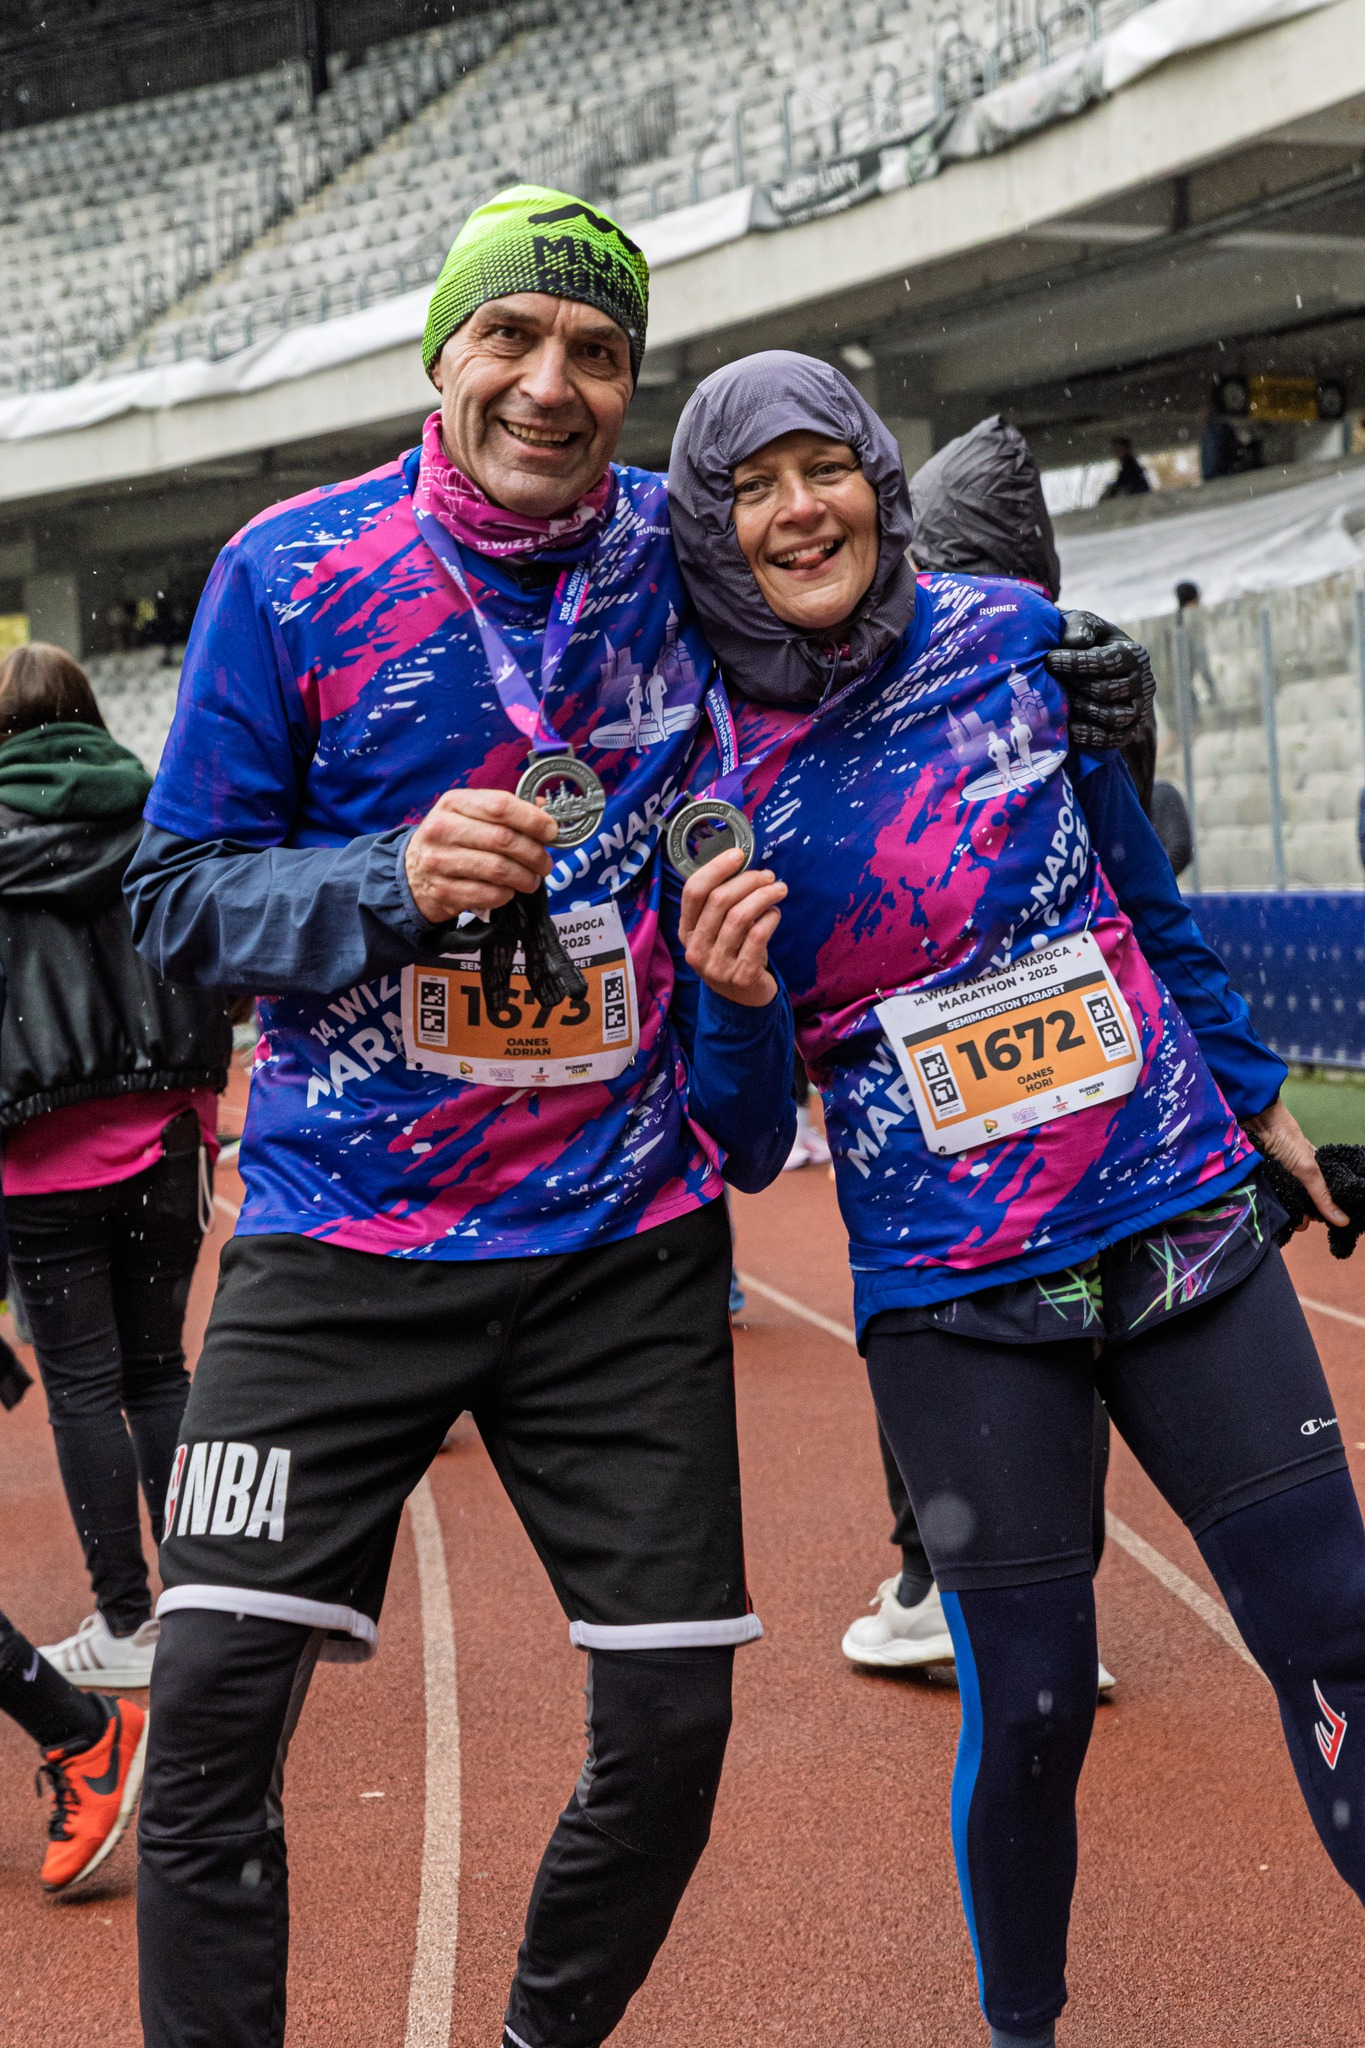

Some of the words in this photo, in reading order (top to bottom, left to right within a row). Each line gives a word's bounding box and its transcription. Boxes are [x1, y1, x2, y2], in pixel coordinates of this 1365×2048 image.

[558, 600, 572, 622] 2025
[980, 604, 1018, 617] RUNNEK
[707, 688, 729, 750] MARATHON
[722, 754, 730, 777] 2025
[677, 810, 696, 832] YOUR
[561, 935, 591, 950] 2025
[912, 983, 961, 1007] 14.WIZZ
[937, 977, 1018, 1012] MARATHON
[1027, 964, 1058, 982] 2025
[946, 997, 1022, 1031] SEMIMARATON
[1021, 984, 1066, 1006] PARAPET
[504, 1047, 551, 1057] ADRIAN
[507, 1038, 549, 1047] OANES
[956, 1009, 1086, 1081] 1672
[1017, 1066, 1055, 1085] OANES
[1025, 1079, 1054, 1093] HORI
[177, 1441, 292, 1543] NBA
